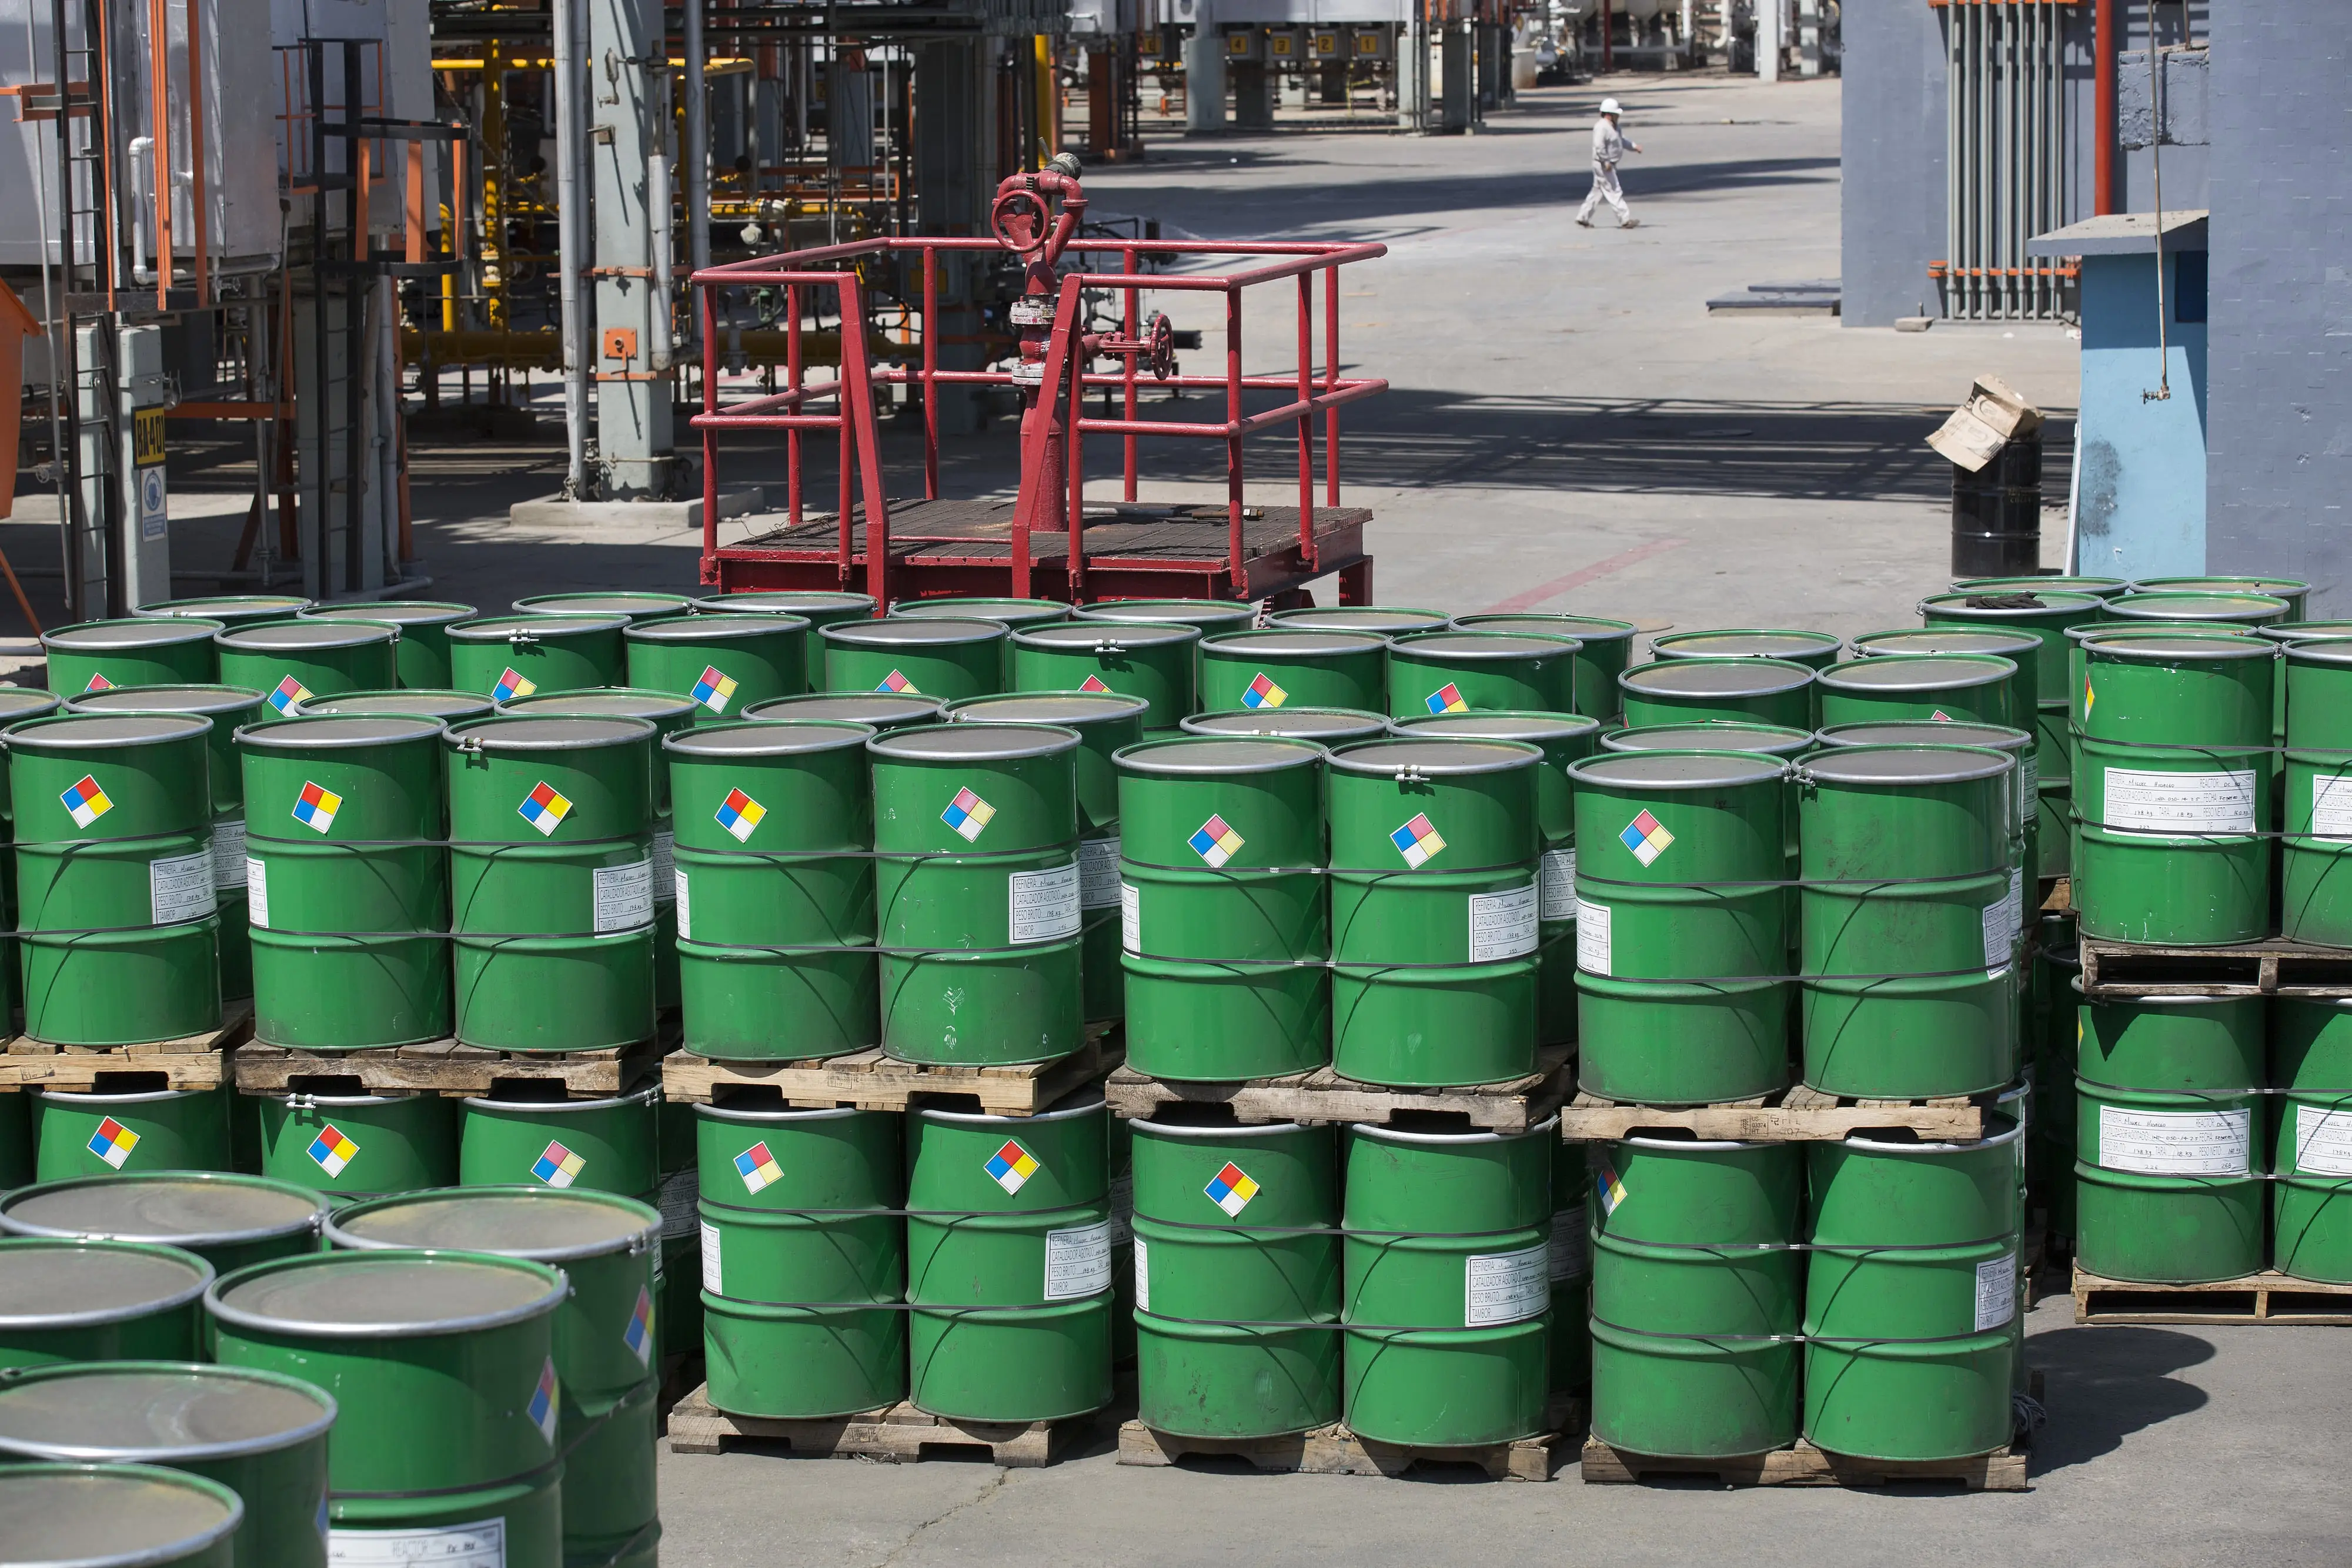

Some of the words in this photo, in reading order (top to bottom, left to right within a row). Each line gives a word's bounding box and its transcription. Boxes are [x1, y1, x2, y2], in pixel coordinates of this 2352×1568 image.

[1235, 39, 1241, 50] 4
[1278, 40, 1285, 51] 3
[1322, 39, 1329, 50] 2
